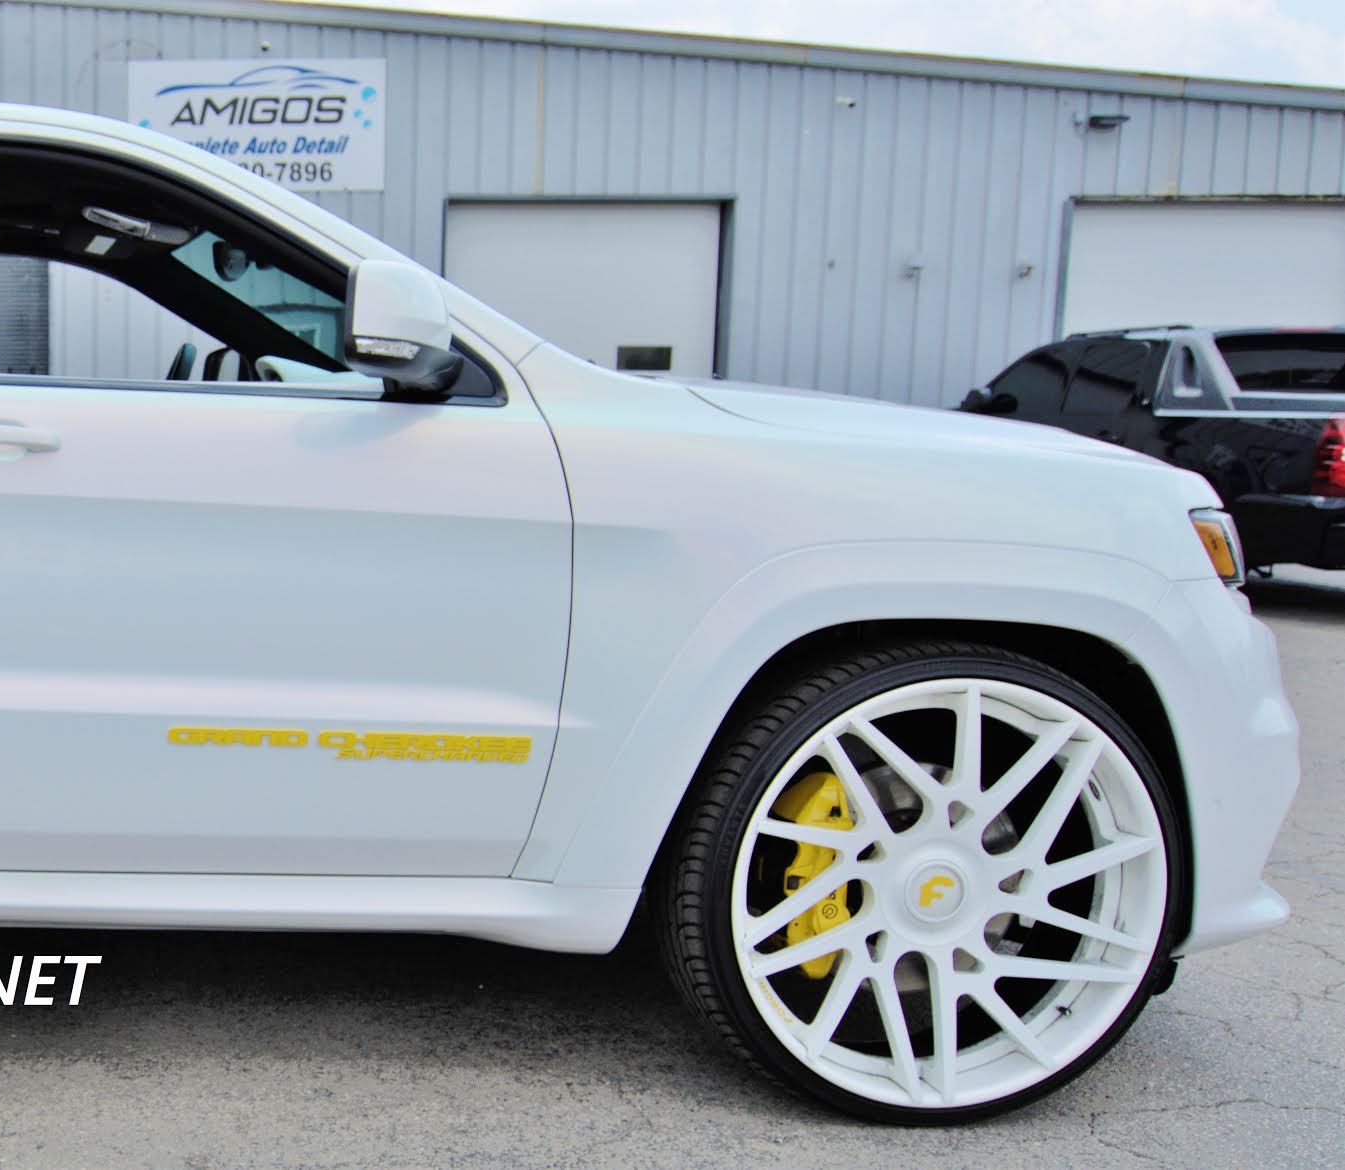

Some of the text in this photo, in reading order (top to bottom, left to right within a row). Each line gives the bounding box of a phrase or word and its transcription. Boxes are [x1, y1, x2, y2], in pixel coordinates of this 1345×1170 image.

[171, 97, 346, 125] AMIGOS
[243, 136, 287, 154] Auto
[292, 136, 349, 154] Detail
[238, 162, 333, 182] 0-7896
[167, 727, 532, 754] GRAND CHEROKEE
